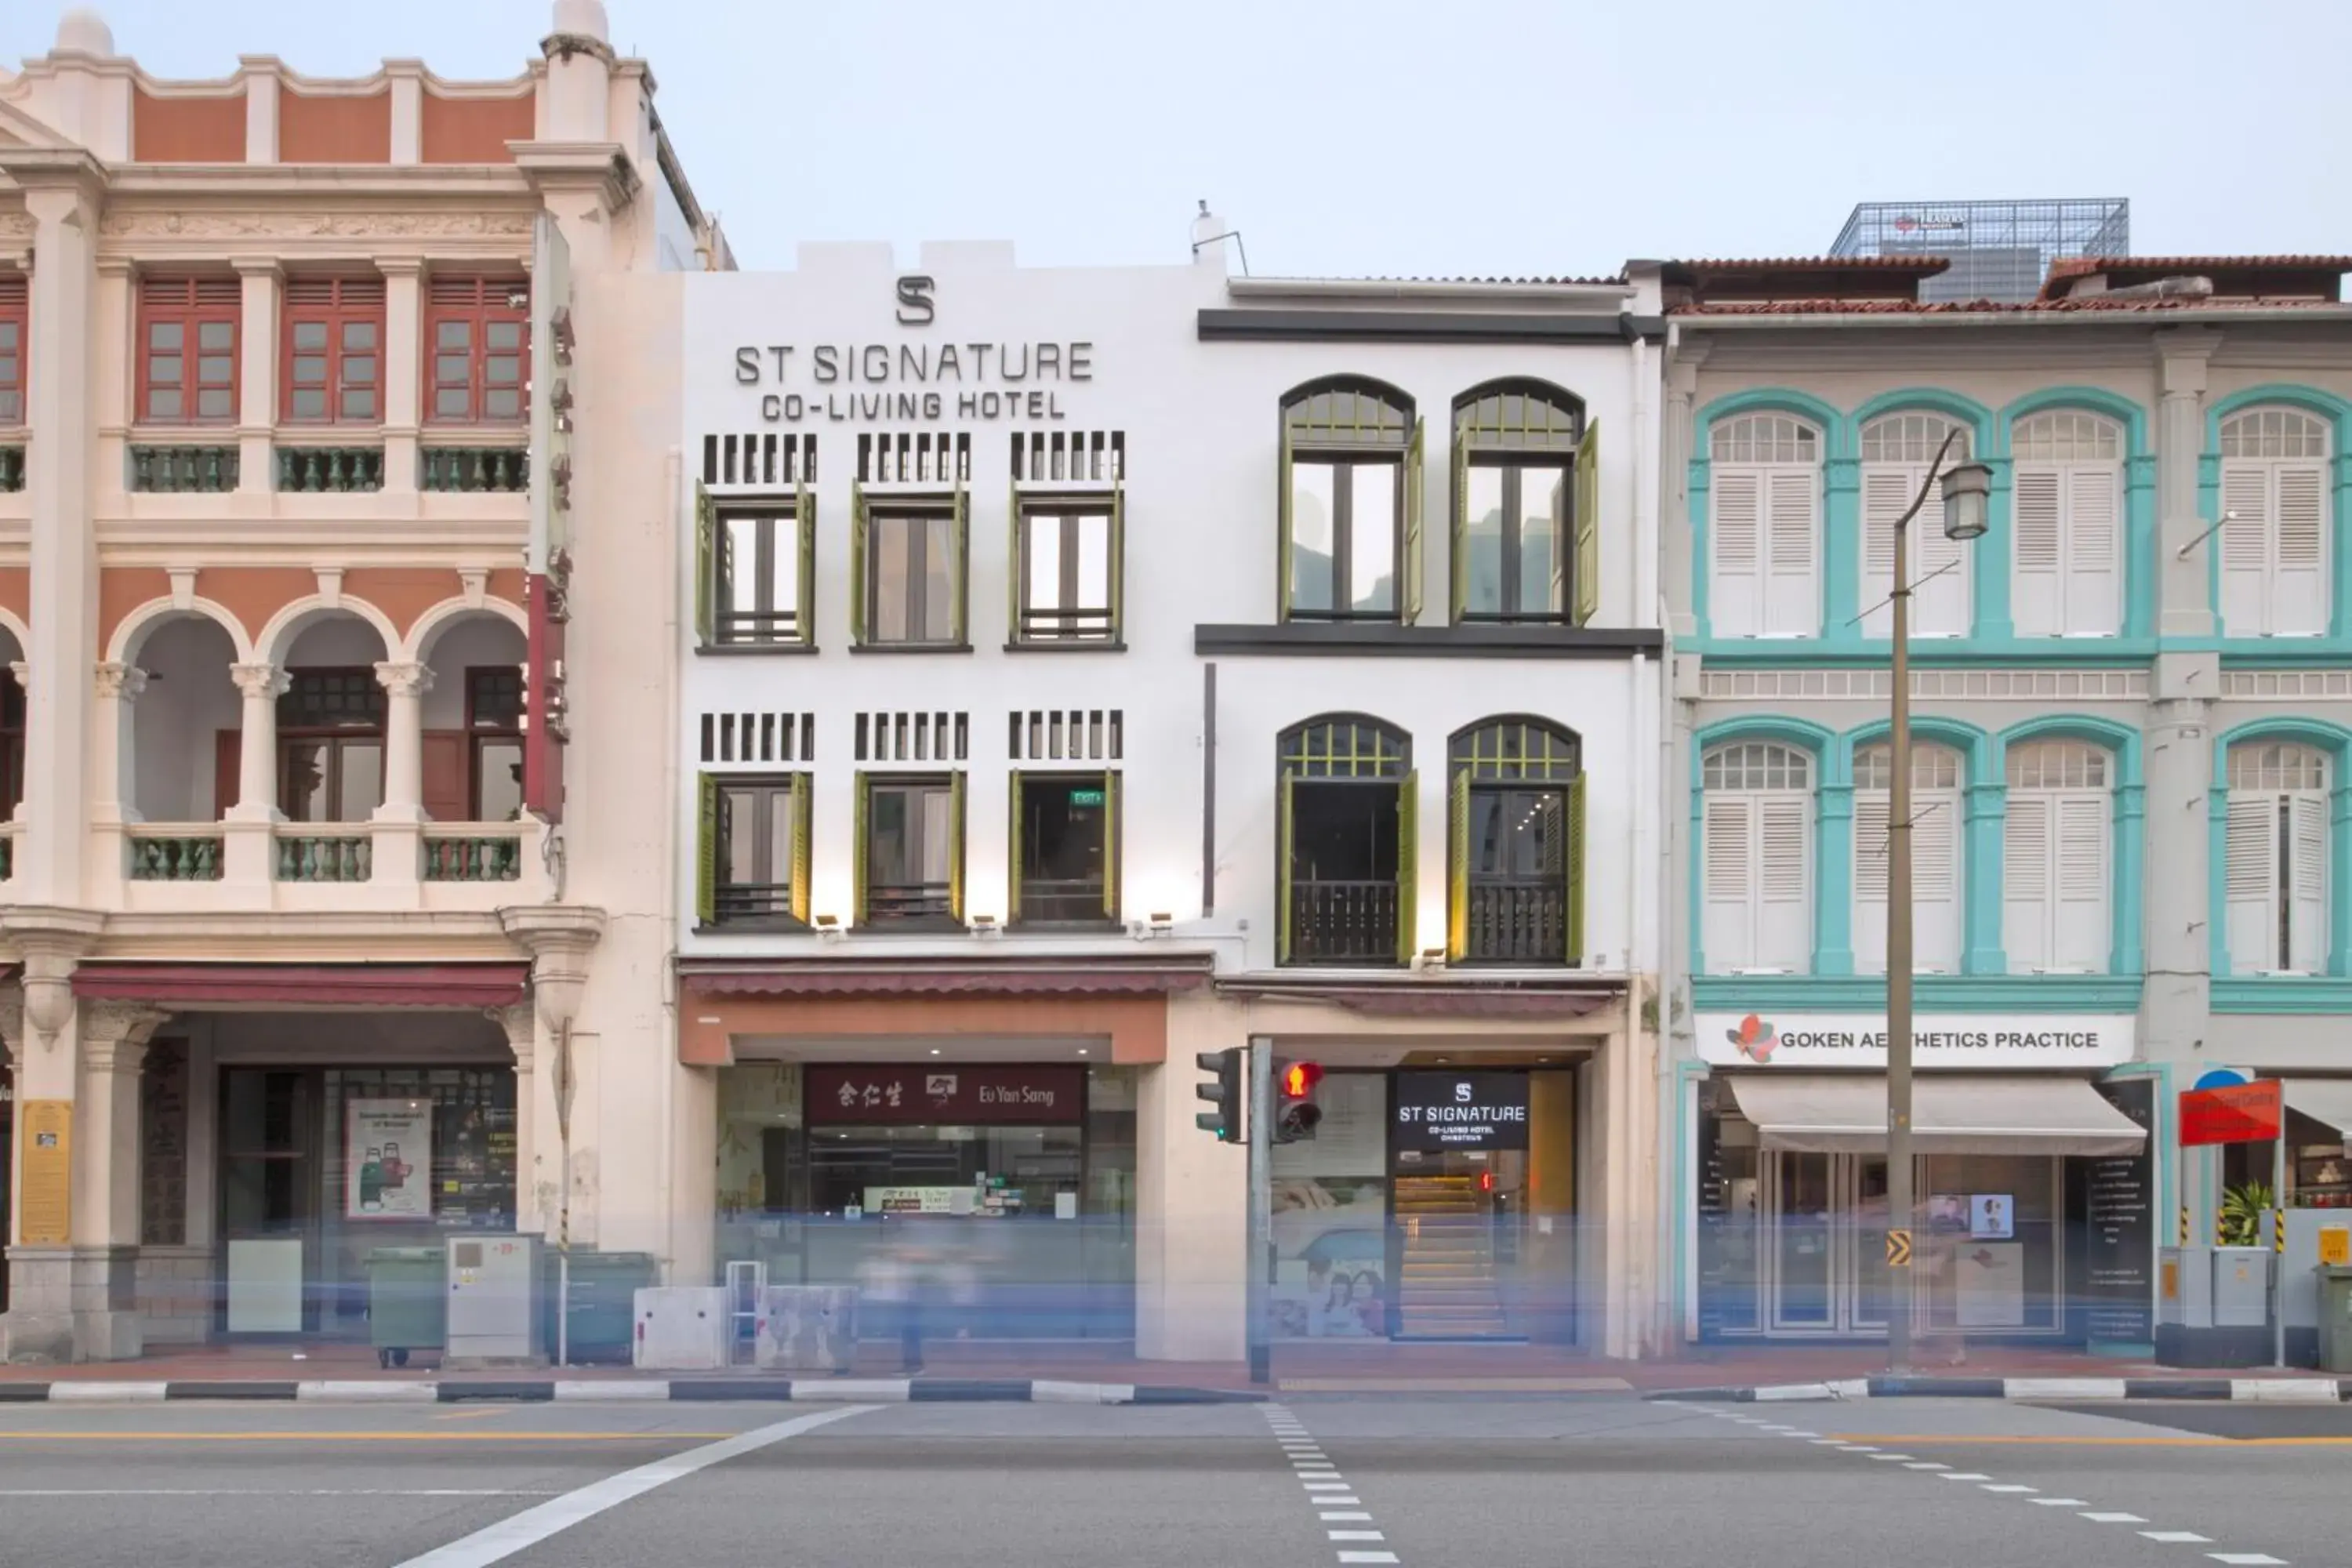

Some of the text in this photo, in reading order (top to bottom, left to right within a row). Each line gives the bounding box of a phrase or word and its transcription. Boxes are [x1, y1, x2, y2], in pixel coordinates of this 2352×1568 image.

[735, 342, 1093, 386] ST SIGNATURE
[762, 390, 1065, 423] CO-LIVING HOTEL
[1780, 1032, 2099, 1048] GOKEN AEHETICS PRACTICE
[979, 1085, 1054, 1106] Eu Yan Sang
[1399, 1106, 1526, 1122] ST SIGNATURE
[1428, 1126, 1495, 1134] CO-LIVING HOTEL
